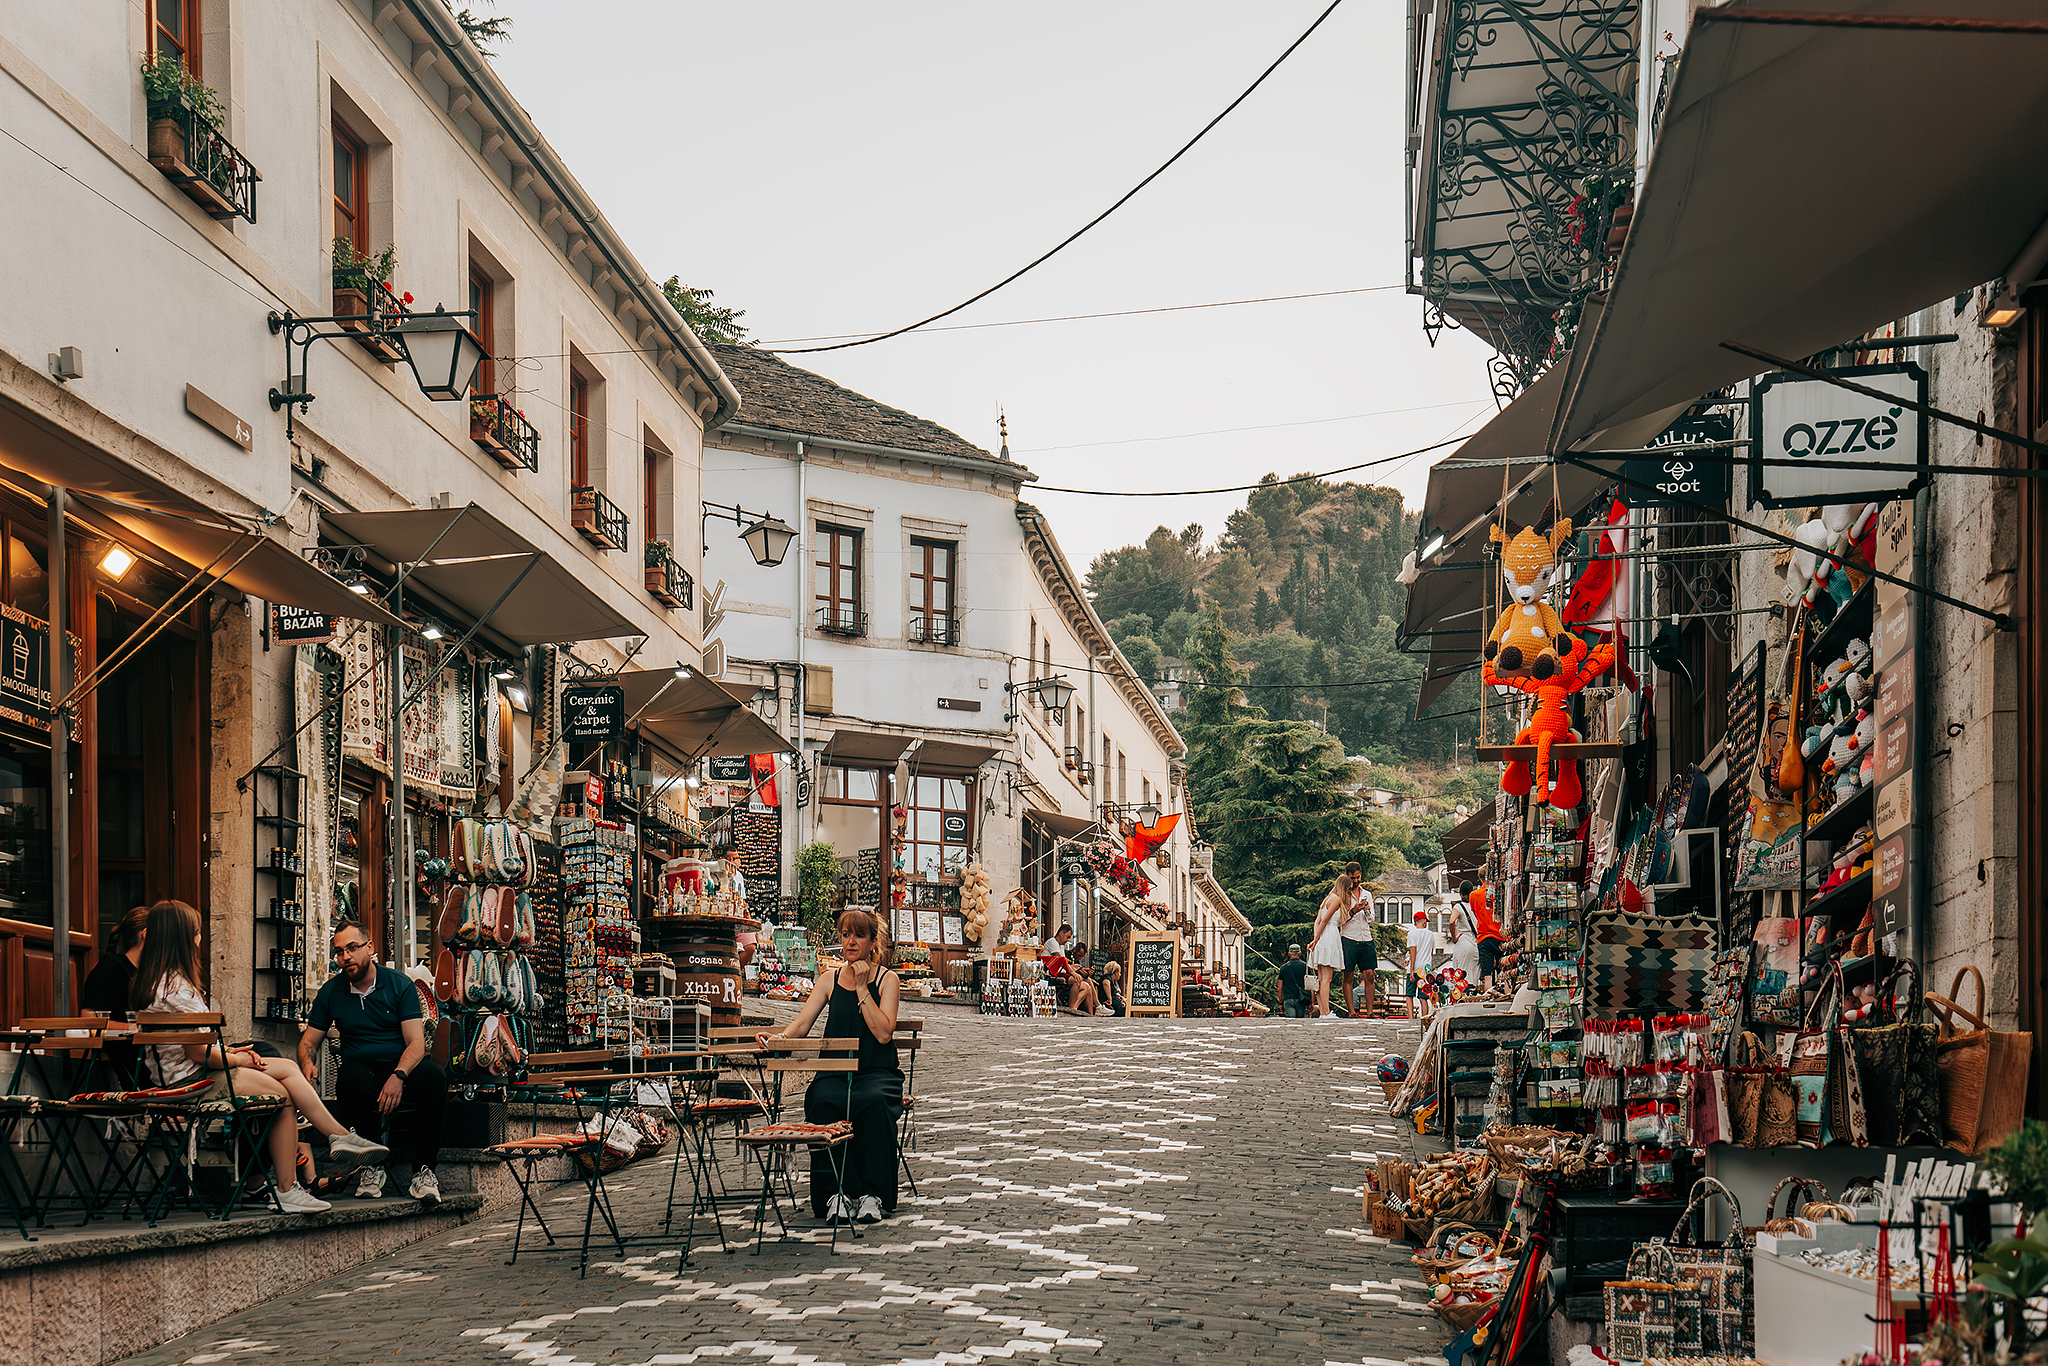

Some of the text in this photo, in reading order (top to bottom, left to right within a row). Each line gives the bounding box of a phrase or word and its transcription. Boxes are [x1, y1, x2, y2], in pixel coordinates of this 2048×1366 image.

[1656, 479, 1700, 495] spot
[283, 616, 324, 631] BAZAR
[2, 676, 38, 698] SMOOTHIE
[569, 693, 615, 706] Ceramic
[586, 705, 597, 716] &
[573, 714, 611, 727] Carpet
[714, 759, 746, 768] Traditional
[1138, 943, 1158, 952] BEER
[689, 955, 723, 966] Cognac
[1136, 965, 1154, 973] Wine
[1135, 973, 1155, 982] Salad
[684, 981, 721, 994] Xhin
